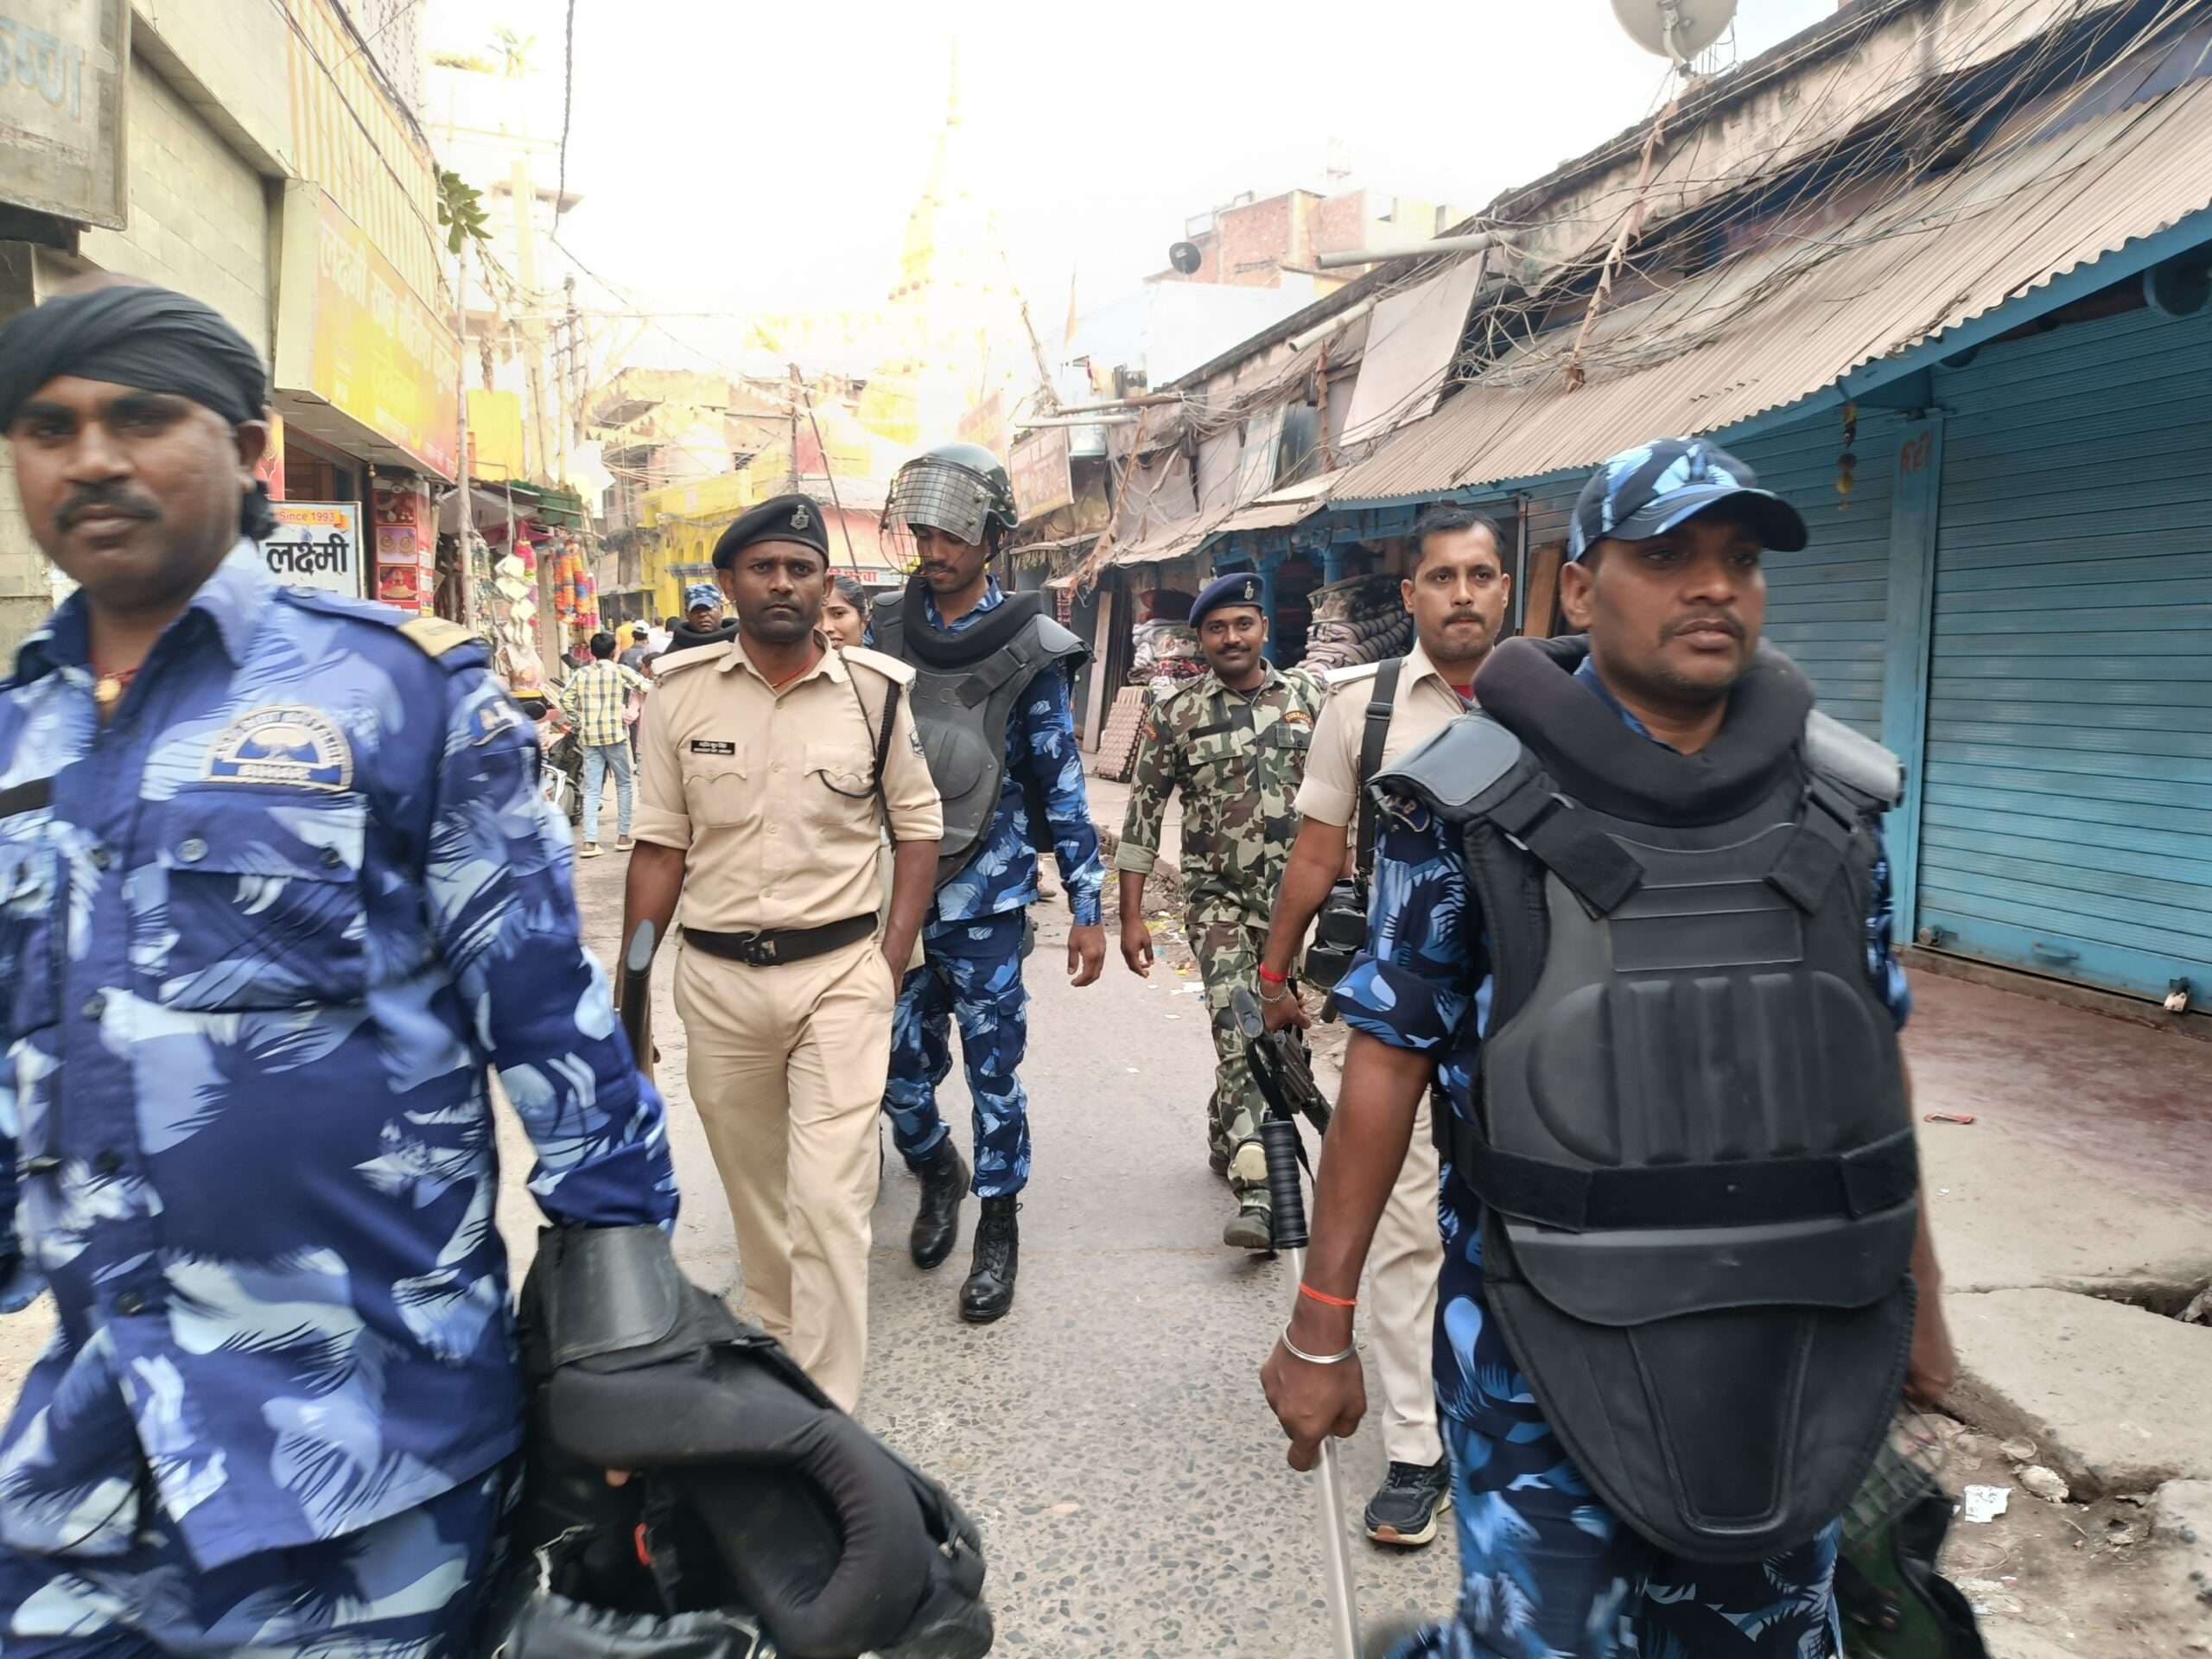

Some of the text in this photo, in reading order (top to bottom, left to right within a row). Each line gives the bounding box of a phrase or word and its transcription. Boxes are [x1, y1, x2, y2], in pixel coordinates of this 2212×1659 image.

[278, 511, 335, 522] Since 1993
[265, 533, 349, 576] लक्ष्मी
